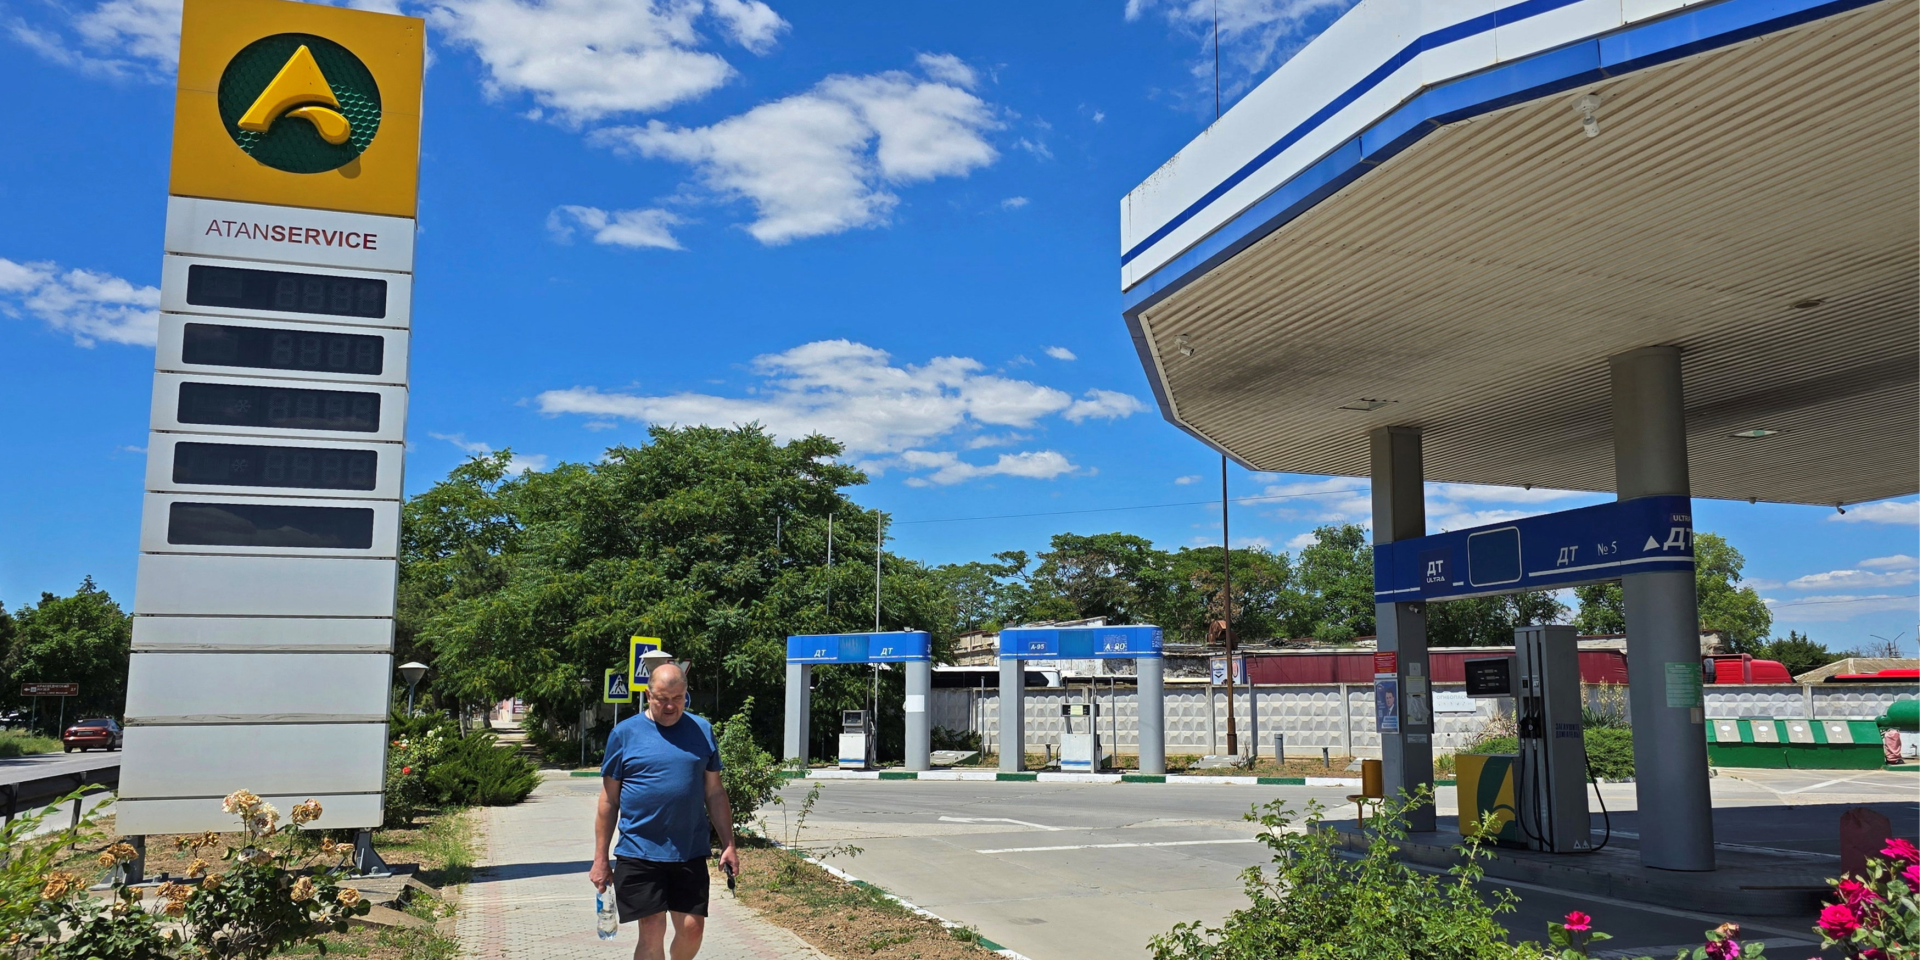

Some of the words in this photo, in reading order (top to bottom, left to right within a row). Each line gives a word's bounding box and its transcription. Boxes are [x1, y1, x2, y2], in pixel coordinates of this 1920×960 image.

[1556, 545, 1579, 567] ДТ
[1611, 541, 1618, 554] 5
[1427, 560, 1444, 577] ДТ
[814, 649, 827, 658] ДТ
[881, 647, 893, 656] ДТ
